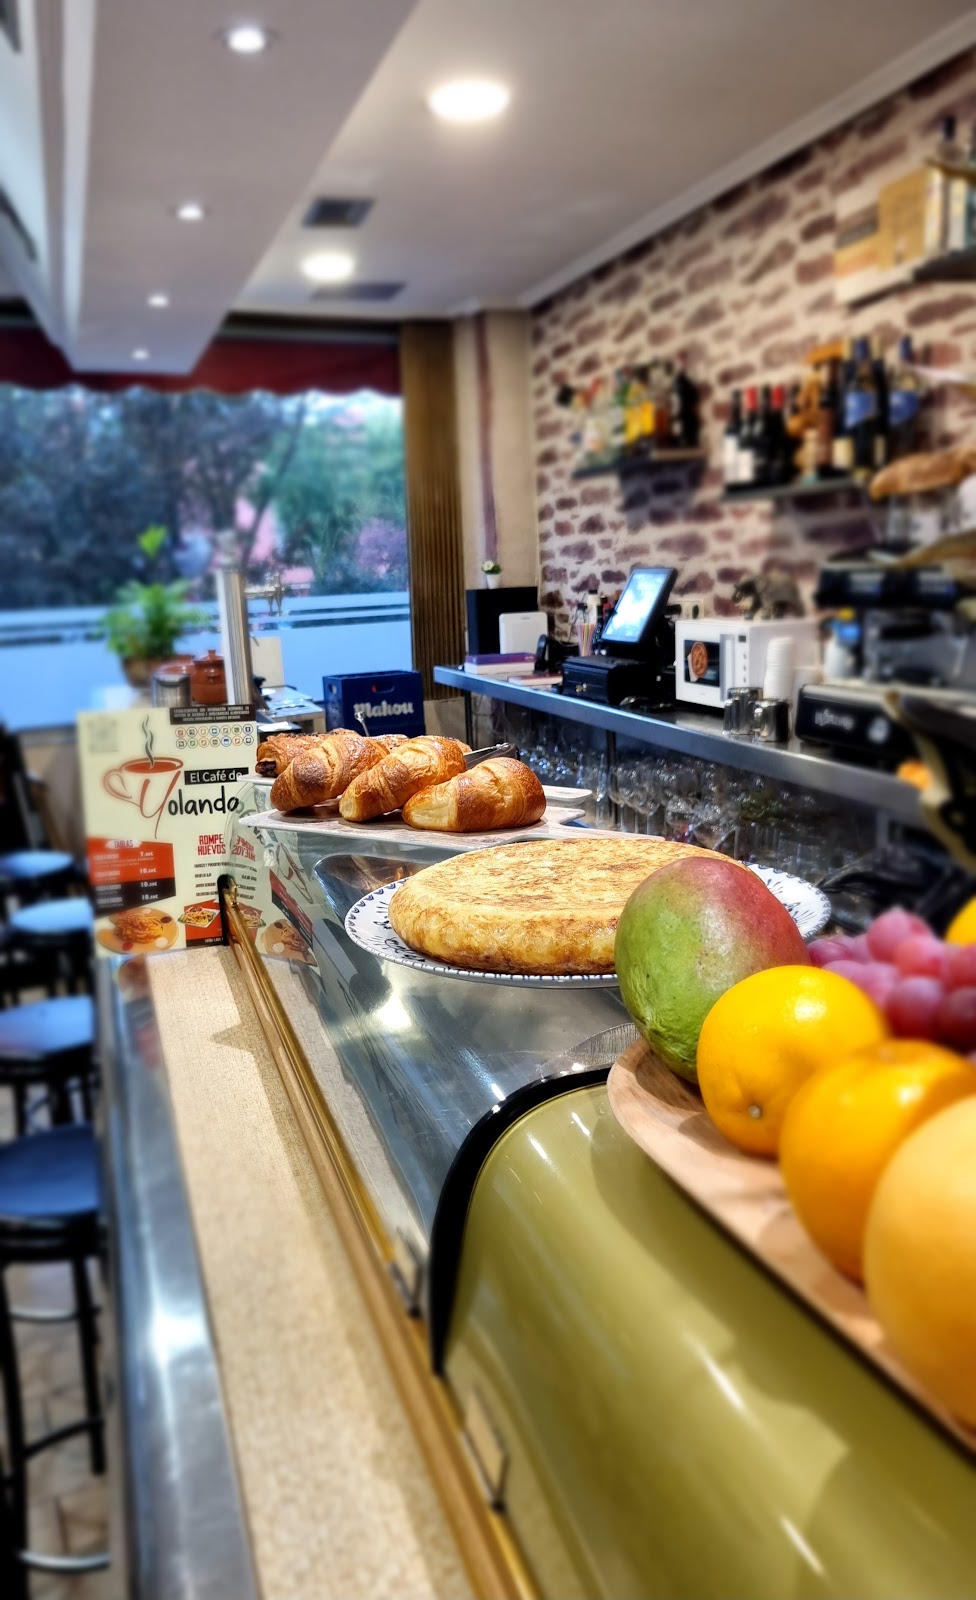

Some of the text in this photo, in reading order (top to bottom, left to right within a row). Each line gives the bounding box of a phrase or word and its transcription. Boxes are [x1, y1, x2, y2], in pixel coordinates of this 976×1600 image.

[353, 700, 415, 718] Mahou
[190, 772, 200, 783] El
[202, 770, 227, 783] Café
[198, 834, 224, 845] ROMPE
[197, 844, 226, 856] HUEVOS
